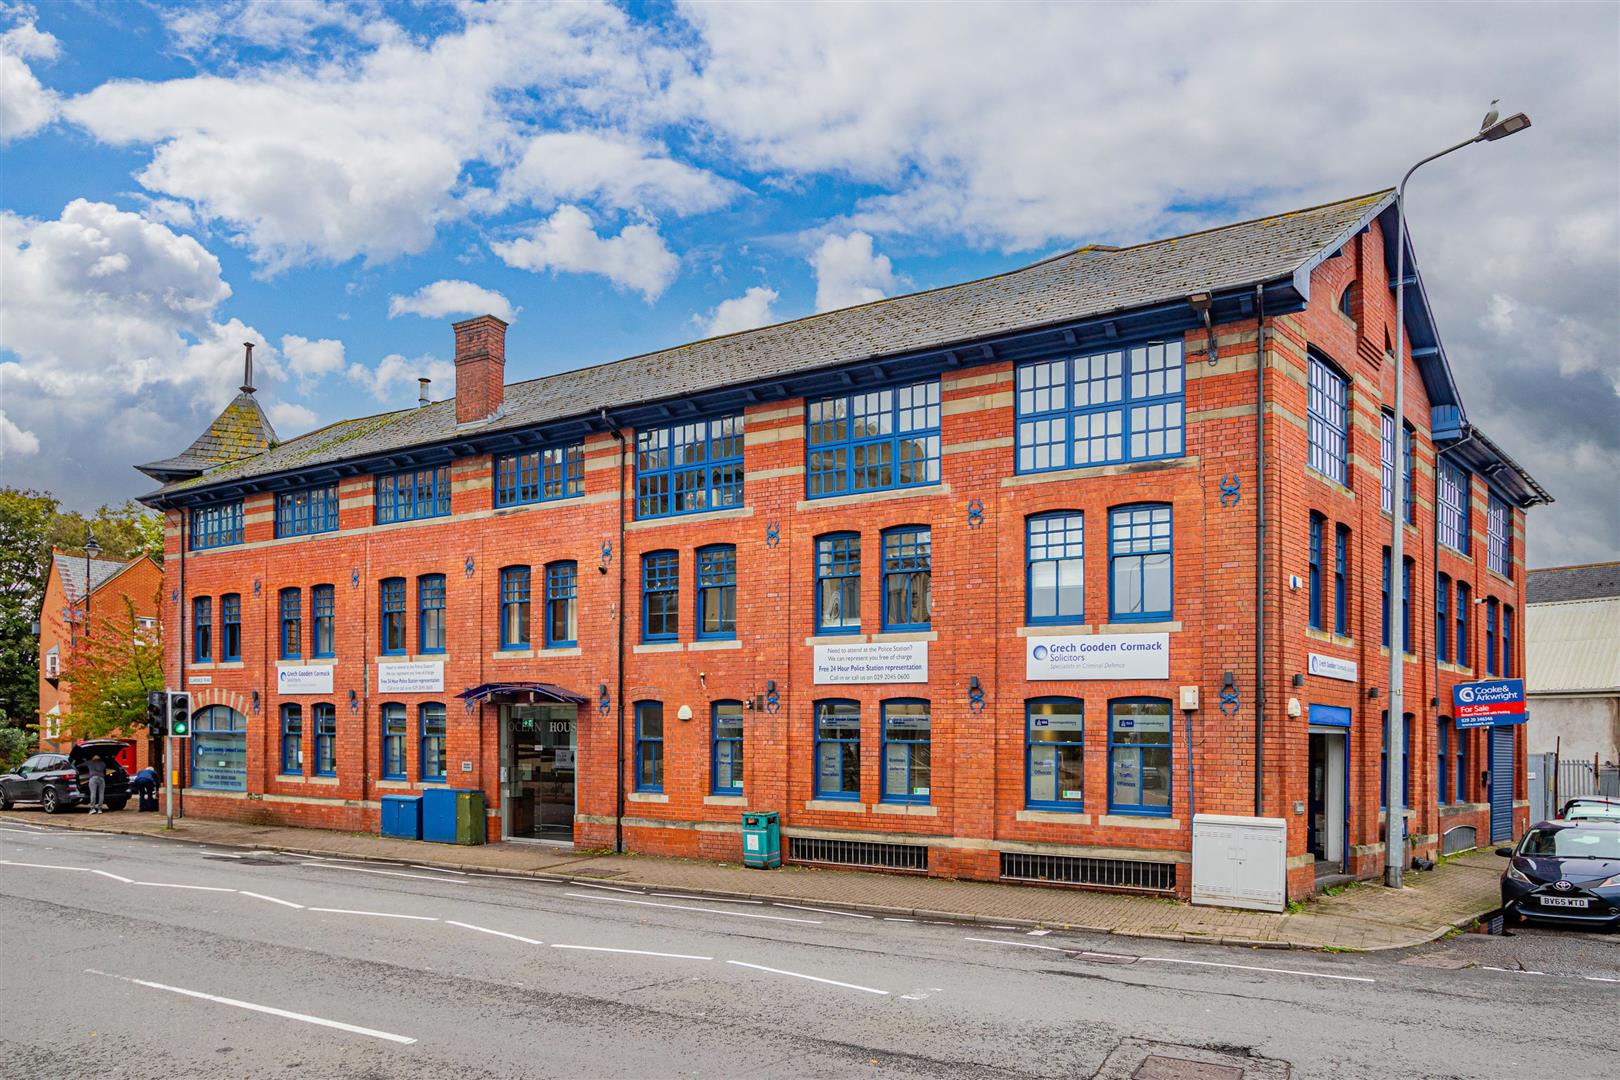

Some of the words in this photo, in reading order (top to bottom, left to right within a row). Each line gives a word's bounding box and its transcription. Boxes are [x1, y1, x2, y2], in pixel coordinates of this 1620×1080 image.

[1050, 644, 1076, 652] Grech
[1080, 642, 1116, 652] Gooden
[1120, 642, 1162, 651] Cormack
[1050, 654, 1085, 662] Solicitors
[1476, 692, 1518, 701] Arkwright
[550, 721, 576, 732] HOUS
